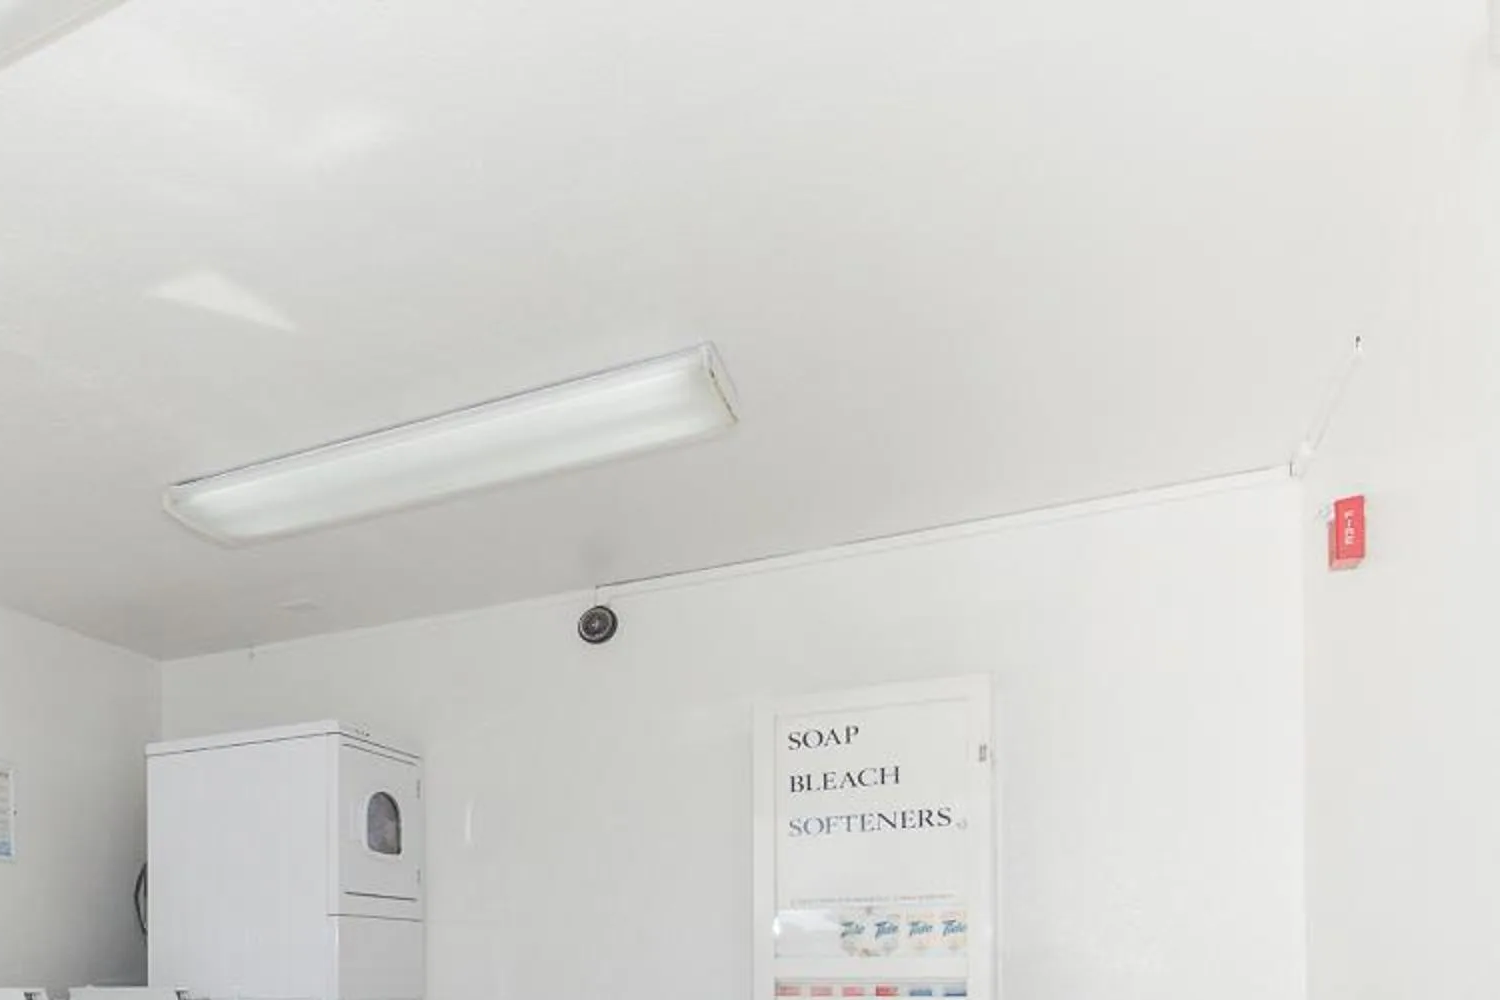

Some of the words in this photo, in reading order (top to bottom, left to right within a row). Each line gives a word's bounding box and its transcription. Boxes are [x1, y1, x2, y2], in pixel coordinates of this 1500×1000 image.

[788, 725, 860, 751] SOAP
[789, 766, 901, 793] BLEACH
[788, 807, 952, 837] SOFTENERS
